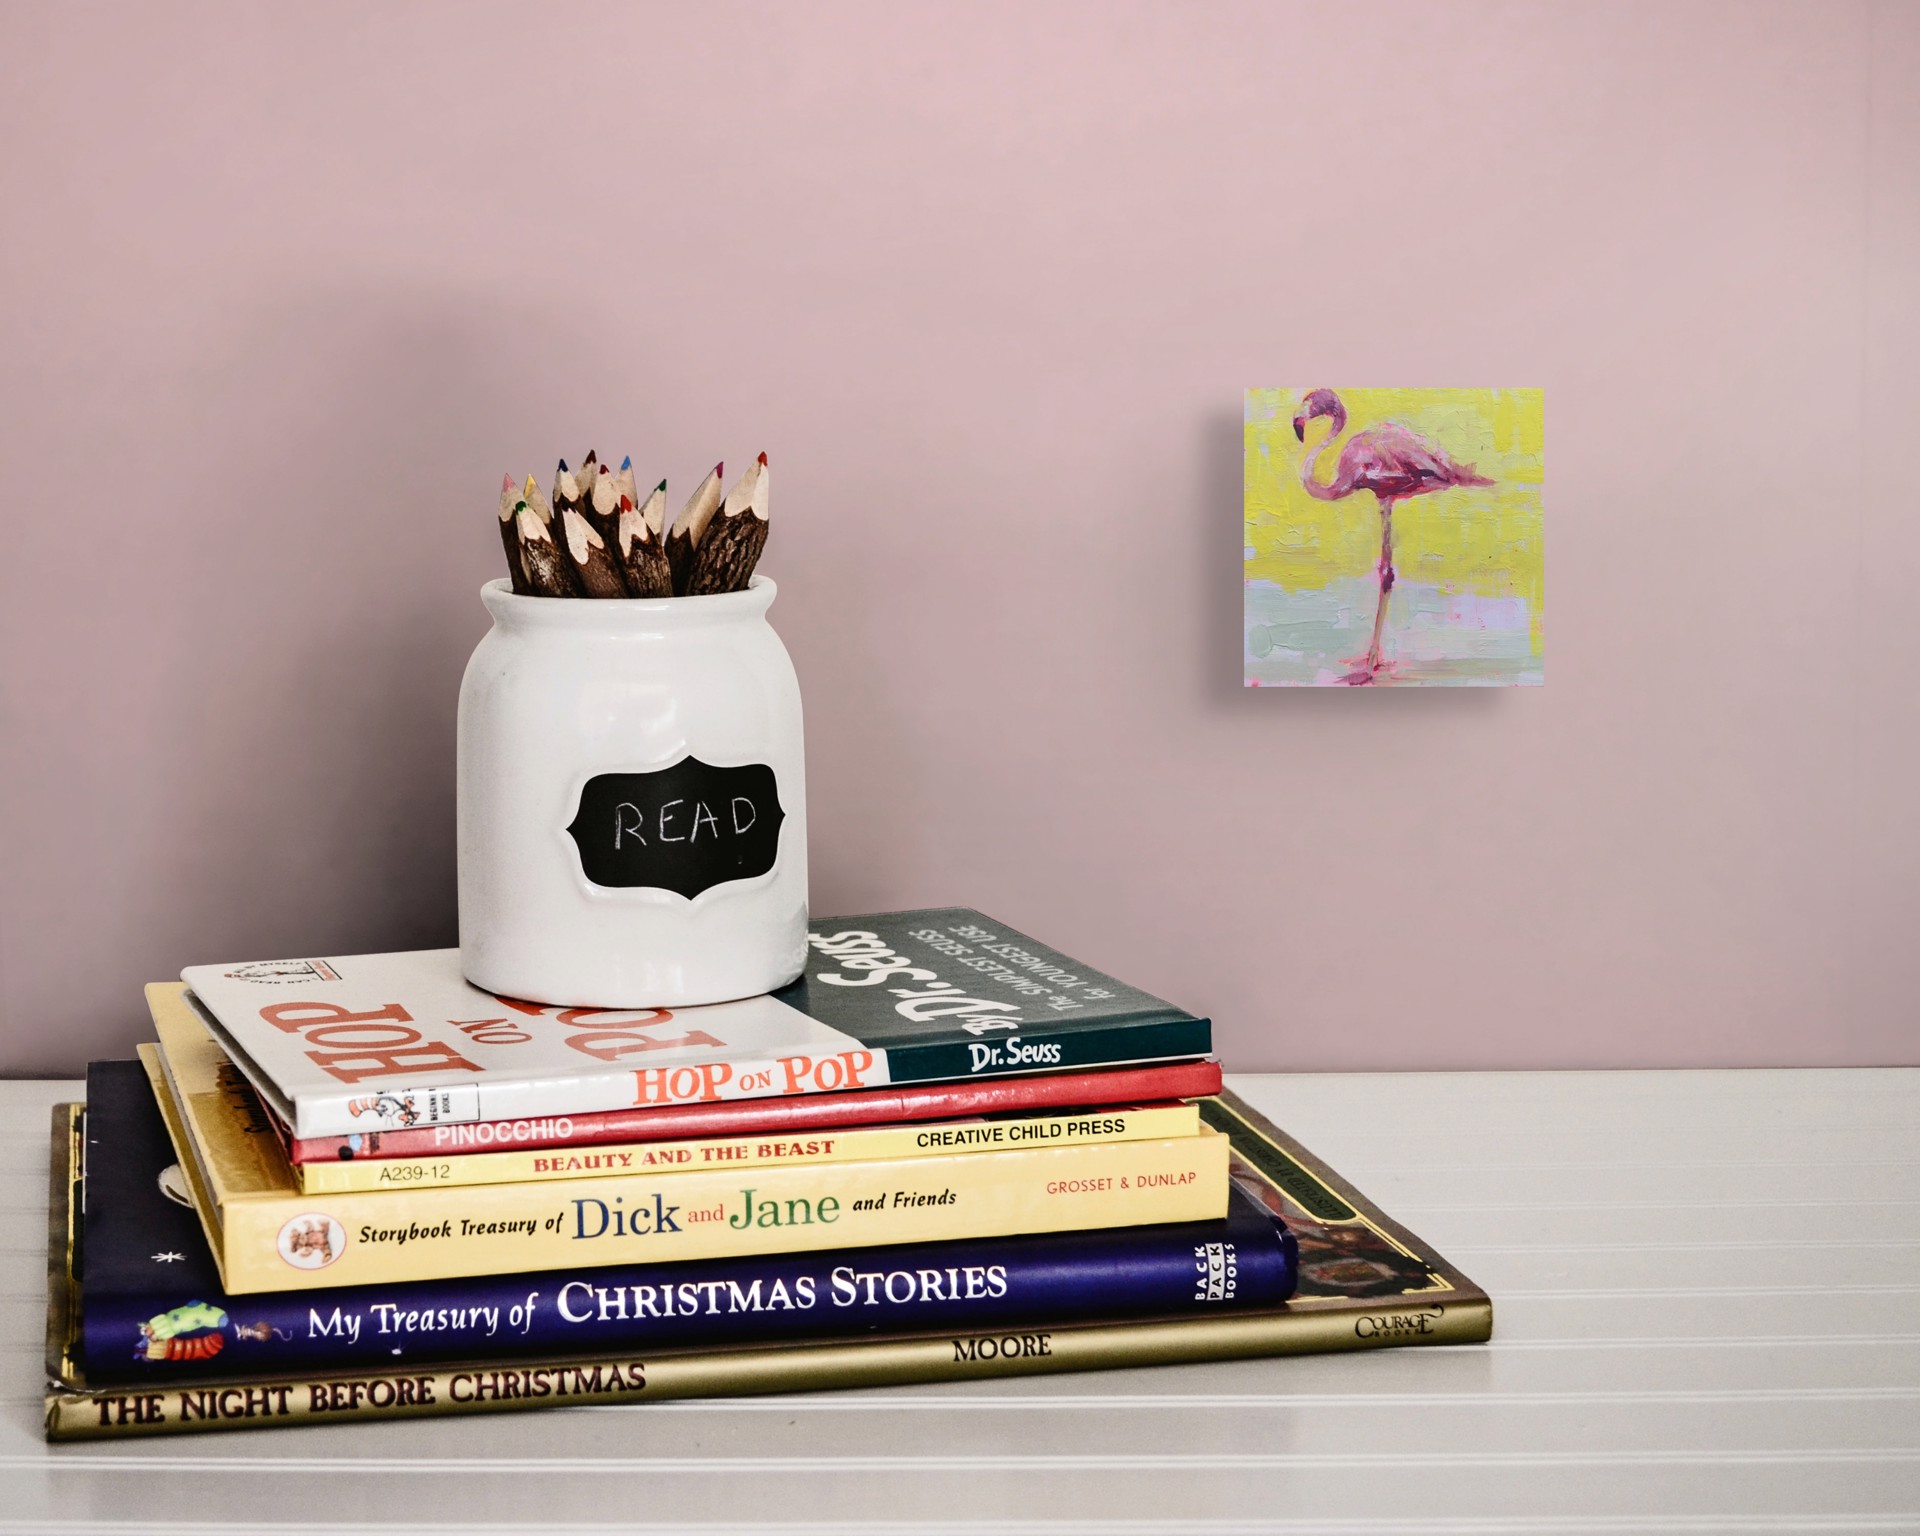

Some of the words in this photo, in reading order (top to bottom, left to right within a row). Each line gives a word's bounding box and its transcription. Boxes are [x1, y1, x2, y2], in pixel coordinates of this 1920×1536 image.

[615, 797, 756, 849] READ
[908, 929, 974, 956] SEUSS
[948, 925, 997, 943] USE
[807, 930, 937, 987] Seuss
[957, 956, 1052, 995] SIMPLEST
[982, 943, 1088, 988] YOUNGEST
[894, 982, 1021, 1022] Dr.
[1048, 995, 1084, 1011] The
[1084, 988, 1116, 1000] for
[259, 1001, 487, 1084] HOP
[446, 1018, 533, 1045] ON
[494, 994, 728, 1062] PO
[1006, 1037, 1062, 1065] Seuss
[629, 1063, 733, 1106] HOP
[739, 1070, 772, 1091] ON
[776, 1050, 873, 1094] POP
[434, 1117, 573, 1147] PINOCCHIO
[916, 1125, 1005, 1148] CREATIVE
[1008, 1122, 1062, 1143] CHILD
[1066, 1118, 1126, 1137] PRESS
[380, 1164, 450, 1182] A239-12
[534, 1152, 633, 1173] BEAUTY
[641, 1148, 692, 1165] AND
[700, 1145, 749, 1161] THE
[757, 1140, 835, 1158] BEAST
[1046, 1177, 1114, 1195] GROSSET
[1120, 1177, 1130, 1189] &
[1136, 1172, 1197, 1189] DUNLAP
[359, 1220, 452, 1246] Storybook
[460, 1216, 538, 1237] Treasury
[545, 1212, 565, 1233] of
[571, 1193, 683, 1240] Dick
[688, 1203, 724, 1223] and
[730, 1189, 840, 1230] Jane
[852, 1192, 886, 1211] and
[893, 1188, 957, 1209] Friends
[1194, 1246, 1208, 1300] BACK
[1209, 1246, 1222, 1298] PACK
[1224, 1243, 1237, 1299] BOOKS
[308, 1306, 361, 1344] My
[370, 1303, 499, 1336] Treasury
[509, 1292, 540, 1334] of
[557, 1276, 817, 1323] CHRISTMAS
[831, 1266, 1008, 1308] STORIES
[1355, 1303, 1444, 1338] COURAGE
[951, 1333, 1053, 1362] MOORE
[92, 1394, 165, 1426] THE
[180, 1385, 294, 1422] NIGHT
[308, 1375, 436, 1413] BEFORE
[449, 1363, 646, 1403] CHRISTMAS
